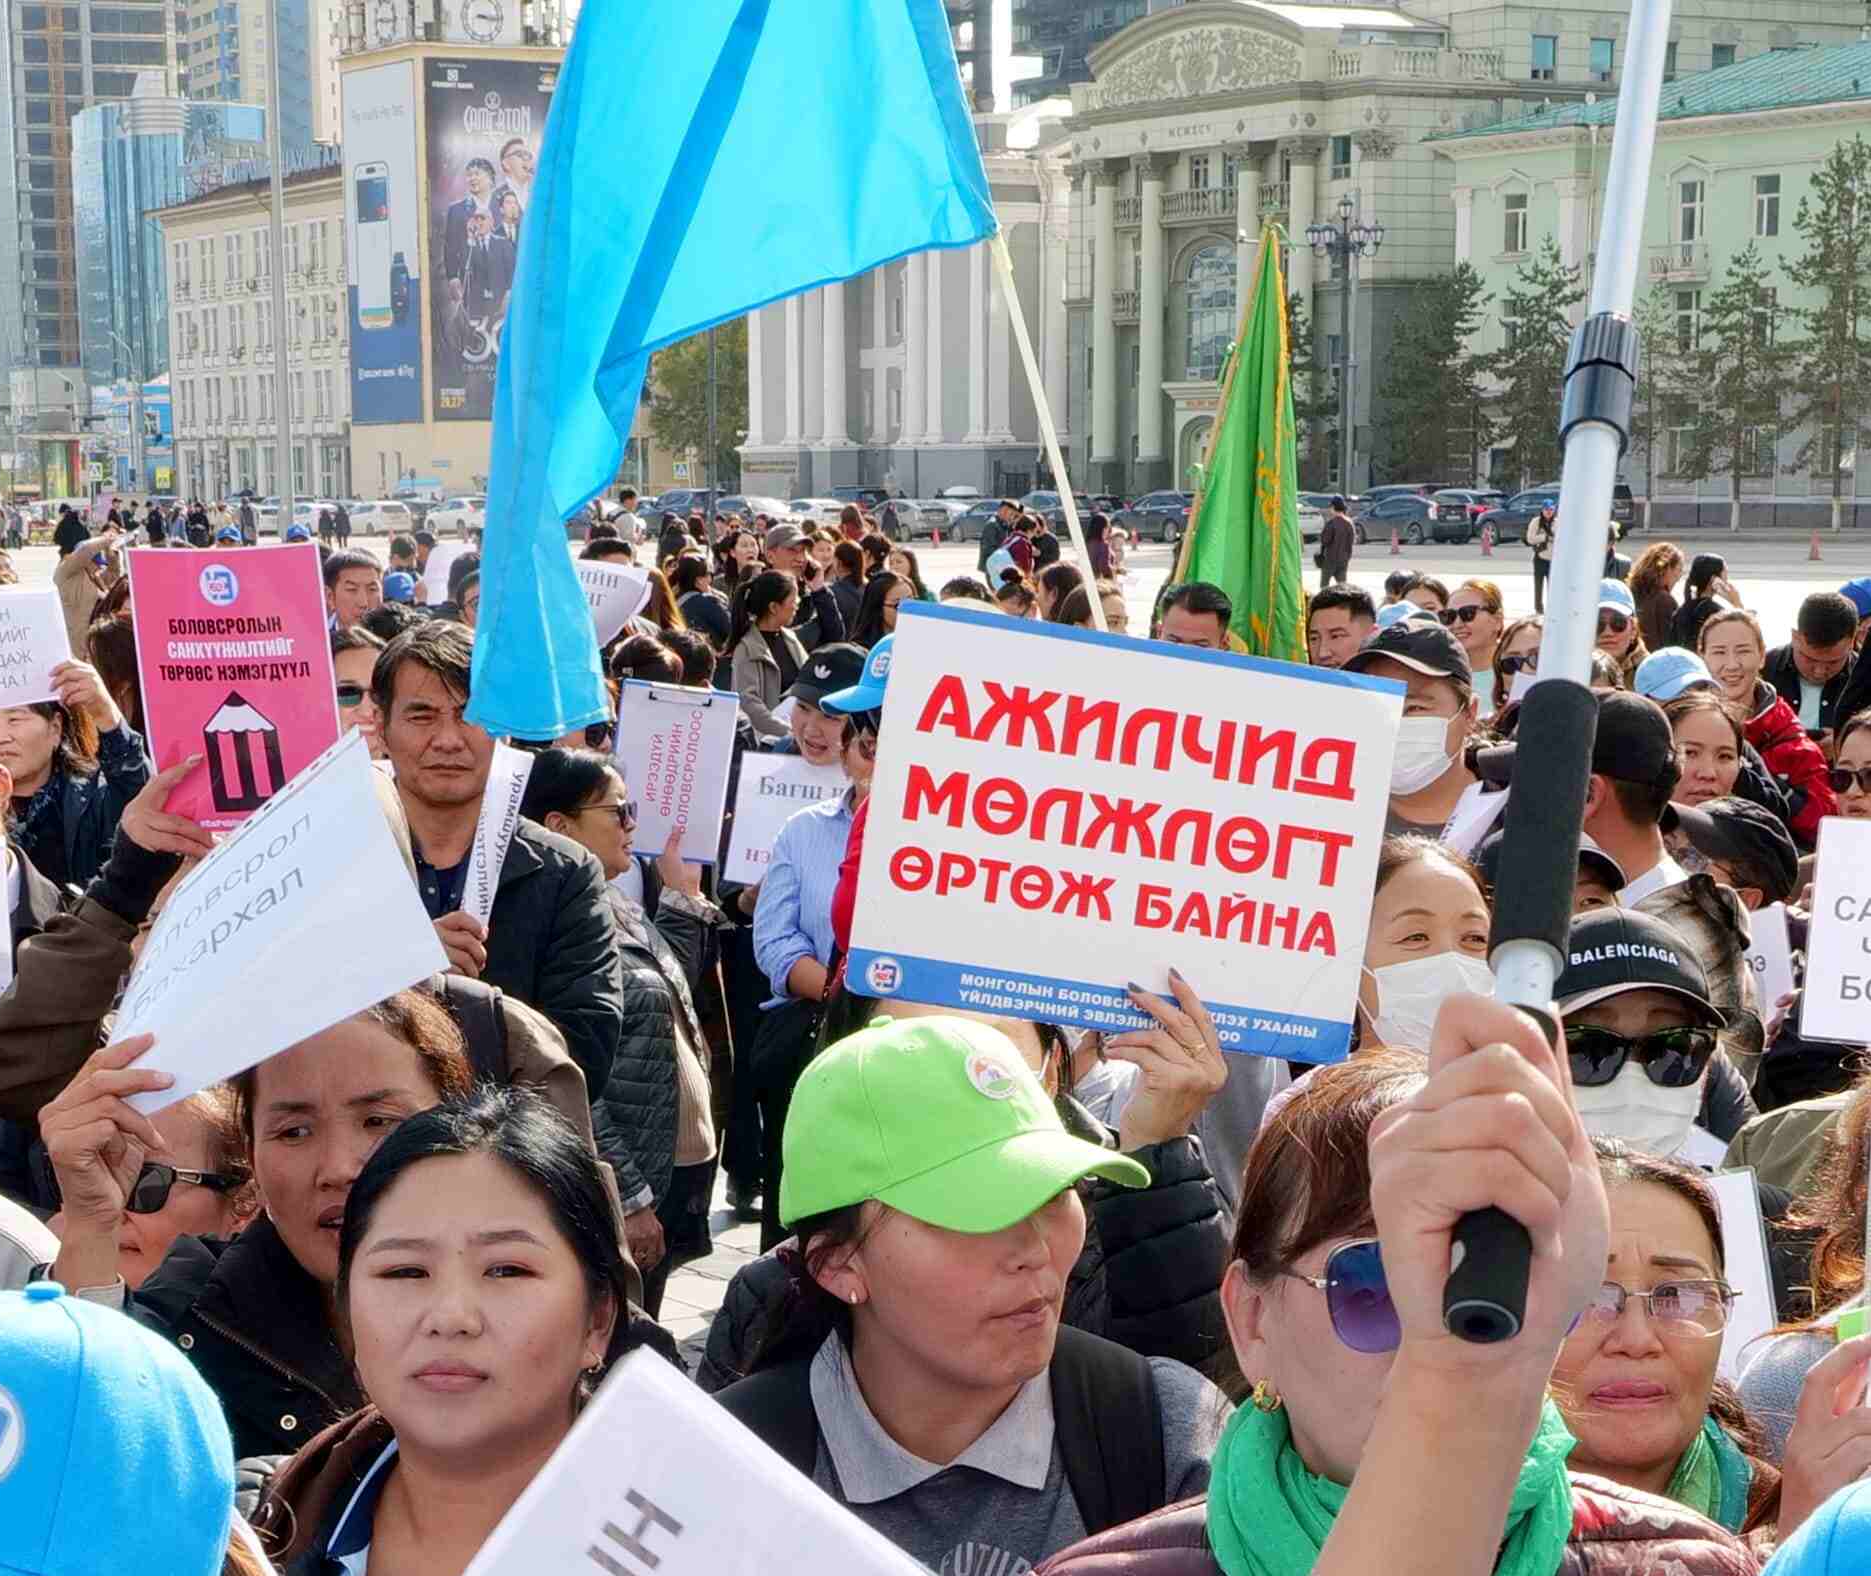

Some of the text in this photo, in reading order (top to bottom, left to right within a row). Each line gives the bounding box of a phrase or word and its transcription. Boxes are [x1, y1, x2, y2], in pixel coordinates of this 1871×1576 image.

[167, 637, 296, 660] САНХҮҮЖИЛТИЙГ
[168, 615, 282, 636] БОЛОВСРОЛЫН
[159, 660, 311, 682] ТӨРӨӨС НЭМЭГДҮҮЛ
[915, 673, 1358, 802] АЖИЛЧИД
[645, 733, 665, 802] ИРЭЭДҮЙ
[659, 722, 684, 818] ӨНӨӨДРИЙН
[758, 776, 823, 800] Багш
[901, 764, 1354, 888] МӨЛЖЛӨГТ
[888, 845, 1339, 958] ӨРТӨЖ БАЙНА
[1570, 943, 1681, 967] BALENCIAGA
[959, 987, 1080, 1019] ҮЙЛДВЭРЧНИЙ
[959, 973, 1054, 999] МОНГОЛЫН
[1251, 1017, 1318, 1040] УХААНЫ
